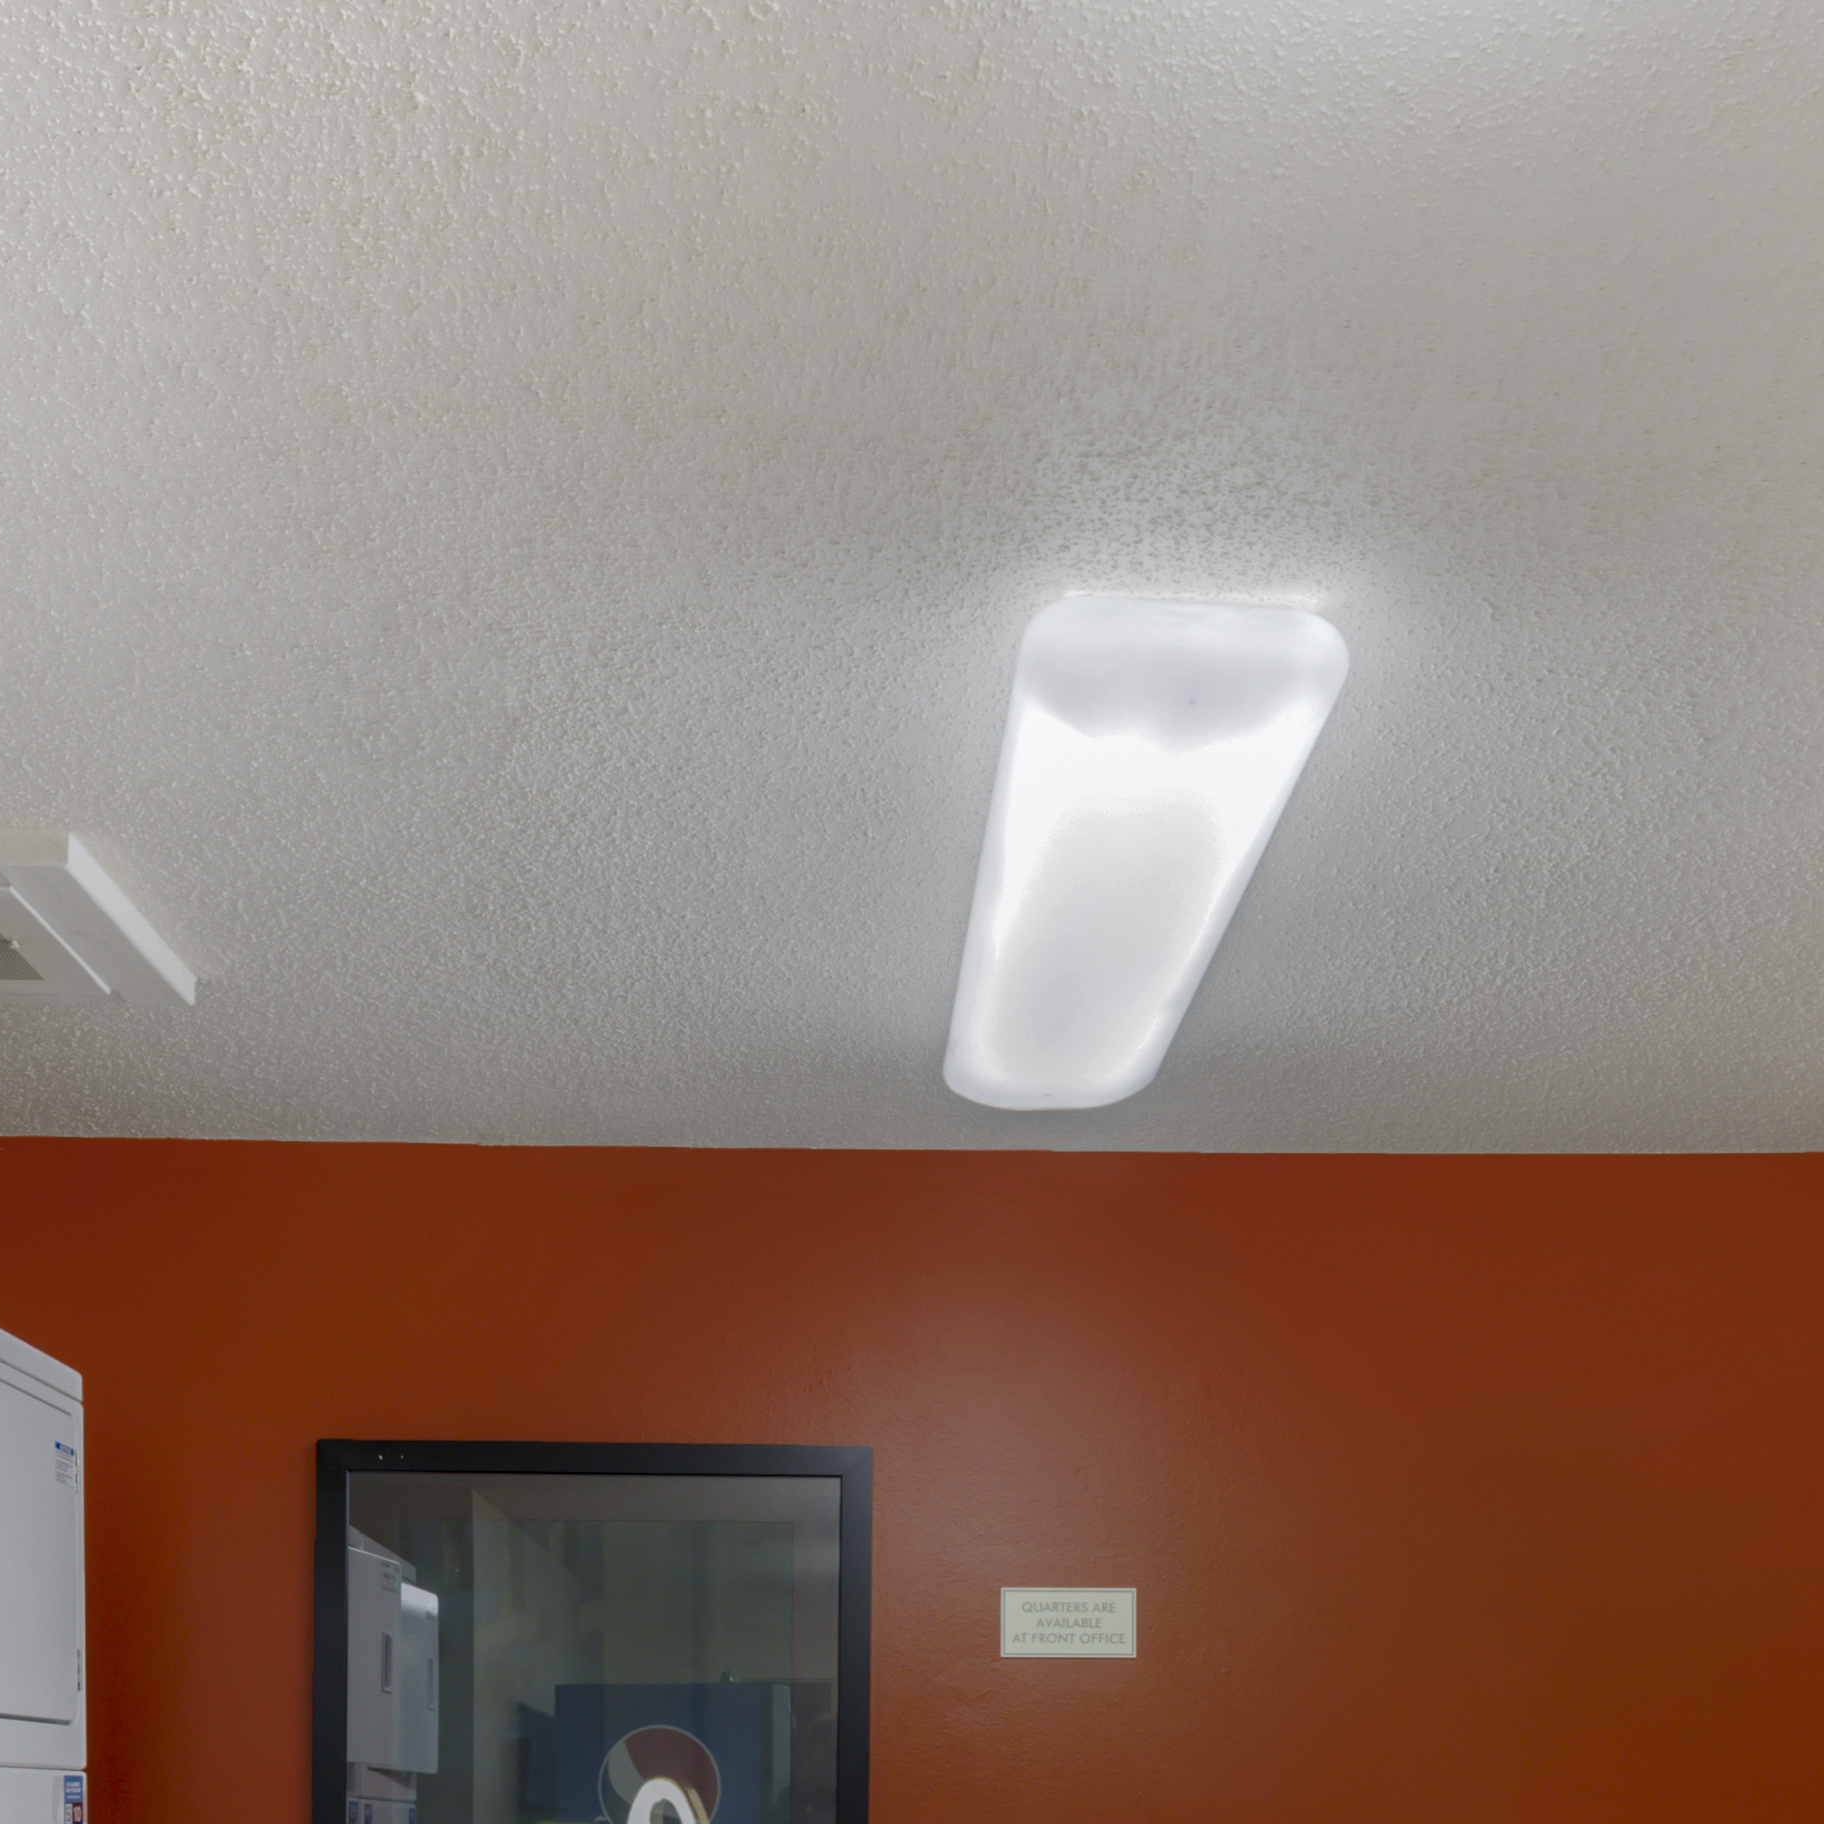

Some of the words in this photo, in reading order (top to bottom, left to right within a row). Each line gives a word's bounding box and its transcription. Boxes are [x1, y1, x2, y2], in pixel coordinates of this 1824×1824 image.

[1022, 1602, 1088, 1613] QUARTERS
[1092, 1602, 1116, 1613] ARE
[1036, 1618, 1102, 1628] AVAILABLE
[1012, 1633, 1028, 1644] AT
[1031, 1633, 1075, 1644] FRONT
[1079, 1633, 1125, 1644] OFFICE
[73, 1806, 82, 1822] 10
